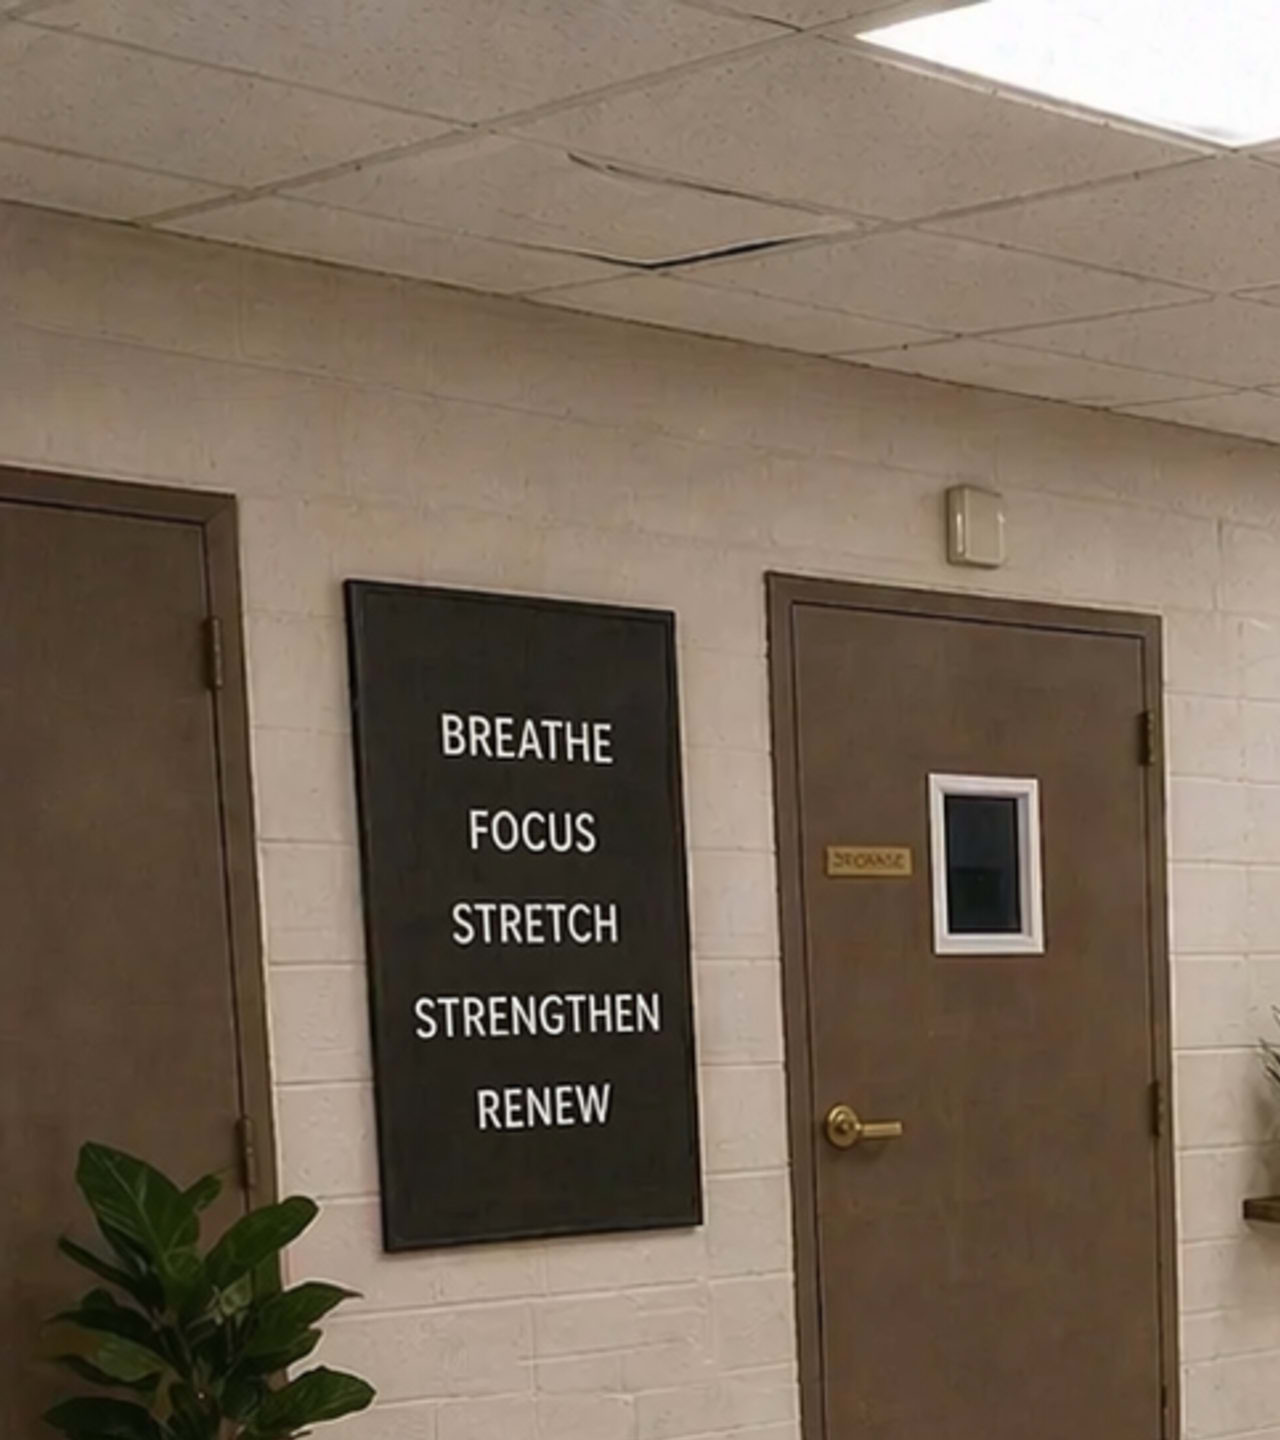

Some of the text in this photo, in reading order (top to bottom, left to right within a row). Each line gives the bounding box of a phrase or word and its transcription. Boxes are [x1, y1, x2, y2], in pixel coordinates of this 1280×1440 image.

[441, 713, 613, 764] BREATHE
[469, 809, 596, 853] FOCUS
[452, 903, 619, 945] STRETCH
[415, 993, 661, 1039] STRENGTHEN
[477, 1083, 612, 1130] RENEW
